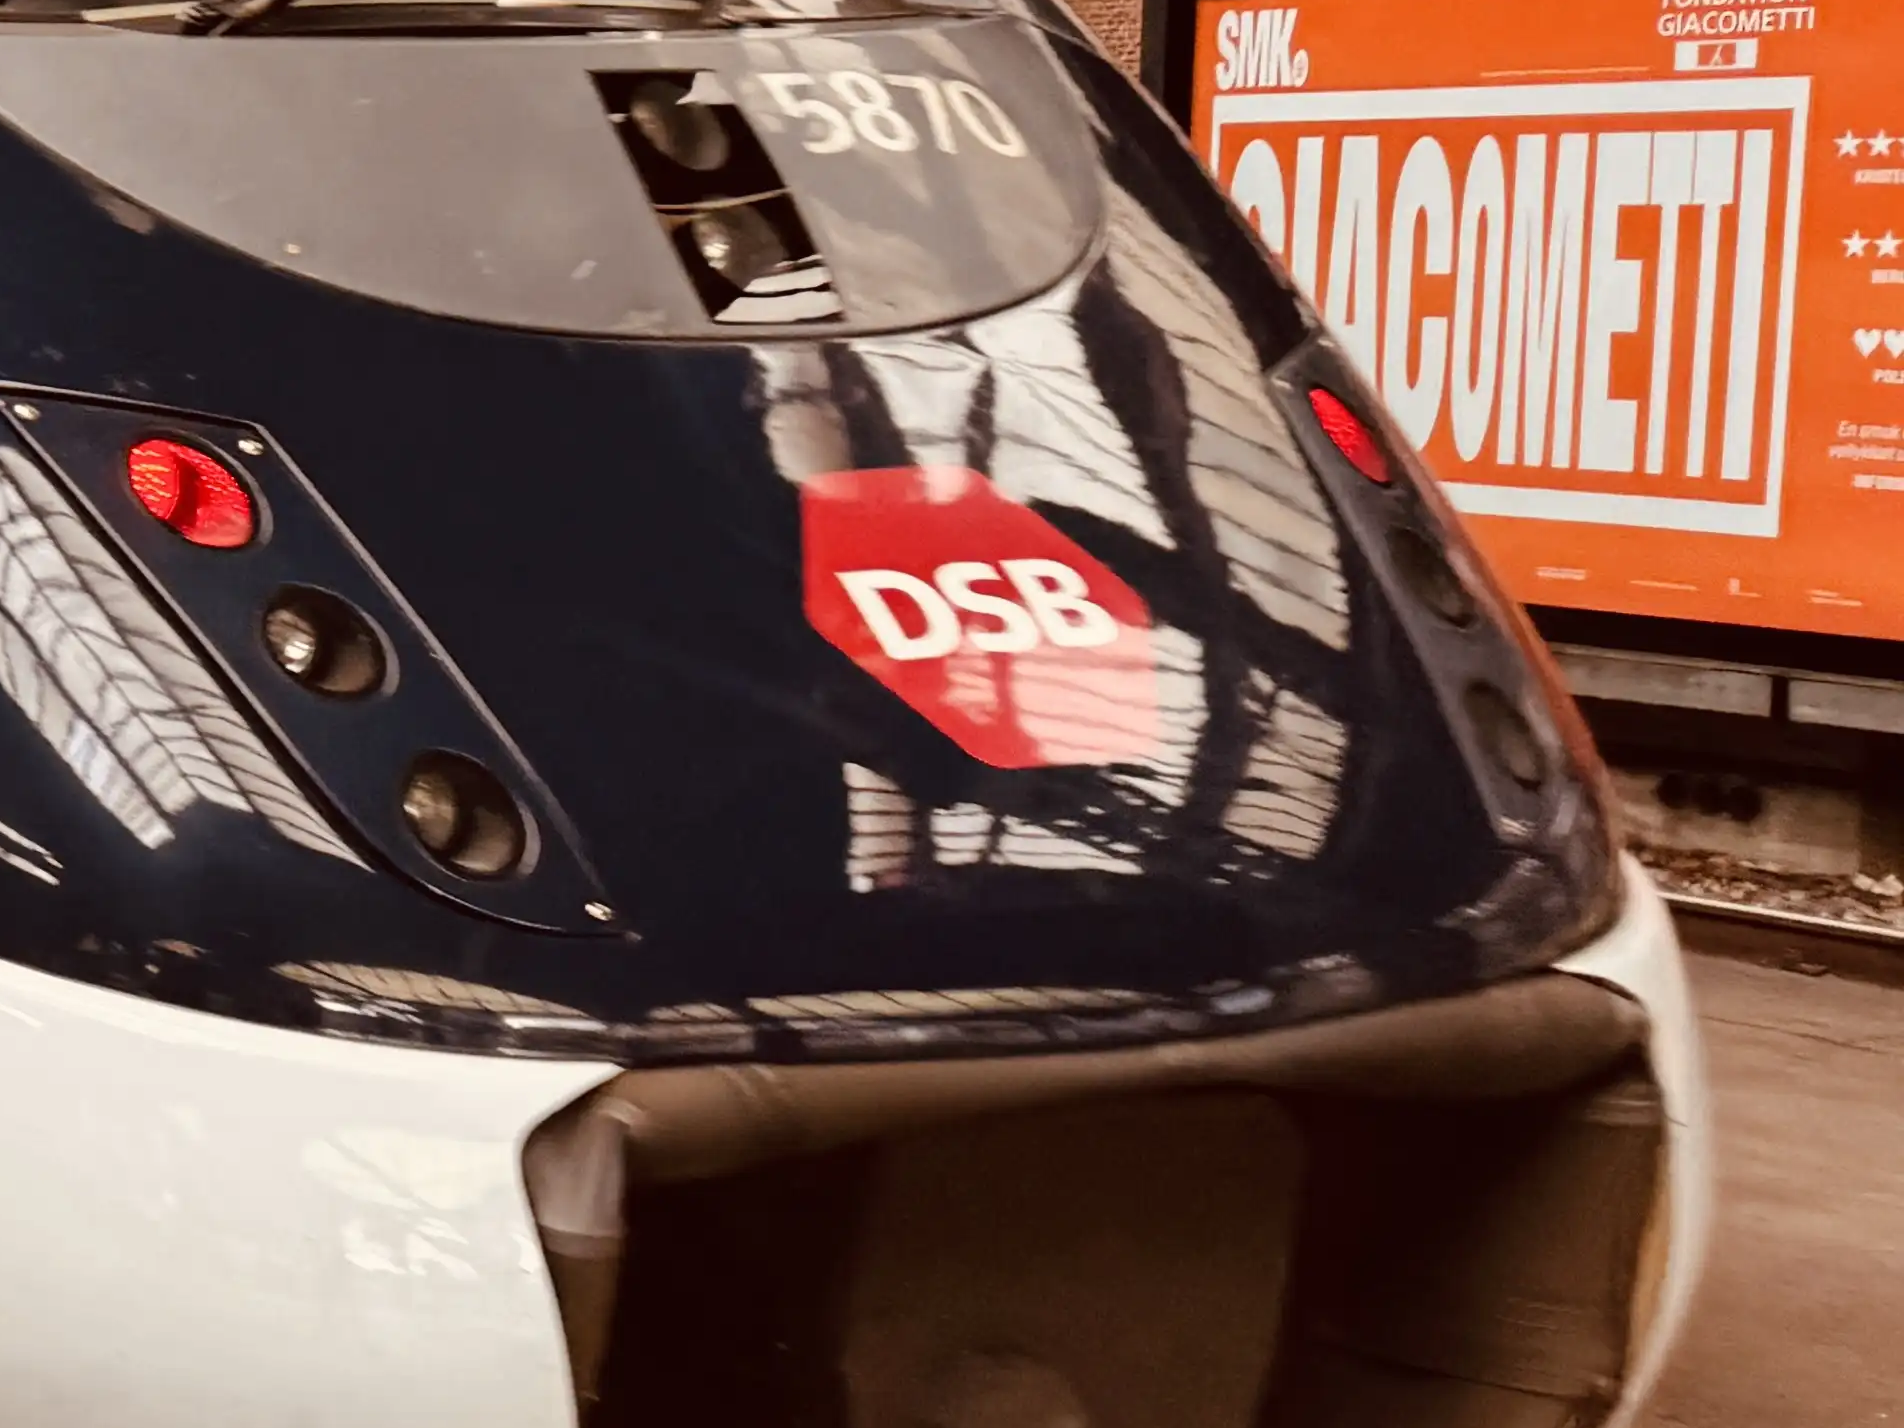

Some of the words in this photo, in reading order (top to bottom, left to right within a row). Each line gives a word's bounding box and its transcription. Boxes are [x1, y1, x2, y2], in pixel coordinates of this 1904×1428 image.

[1656, 6, 1816, 37] GIACOMETTI
[756, 70, 1029, 158] 5870
[832, 557, 1120, 661] DSB
